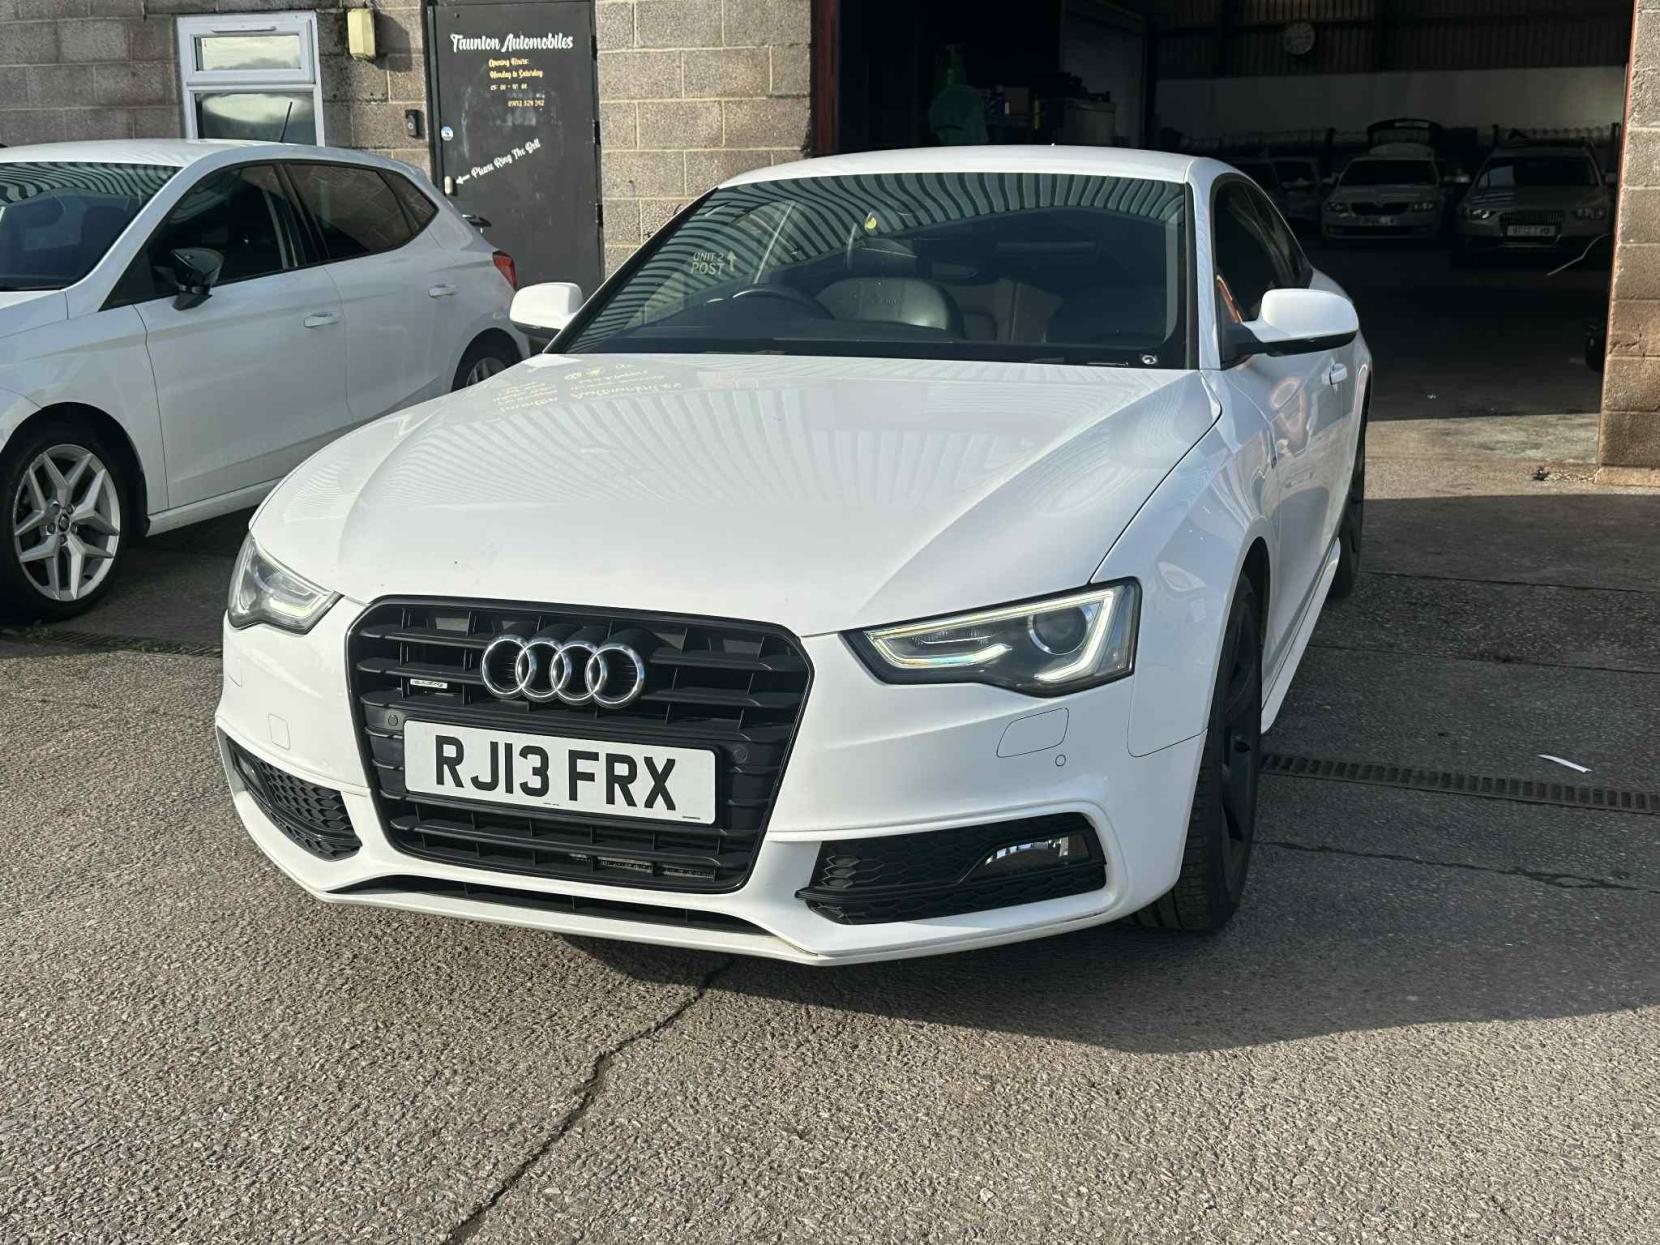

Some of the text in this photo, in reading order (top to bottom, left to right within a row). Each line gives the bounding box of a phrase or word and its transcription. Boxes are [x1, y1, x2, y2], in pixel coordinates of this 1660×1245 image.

[450, 32, 573, 52] Taunton Automobiles
[518, 69, 543, 79] Saturday
[471, 163, 494, 178] Please
[493, 154, 513, 169] Ring
[511, 147, 526, 160] The
[693, 251, 716, 262] UNIT
[691, 261, 725, 275] POST
[435, 734, 676, 811] RJ13 FRX
